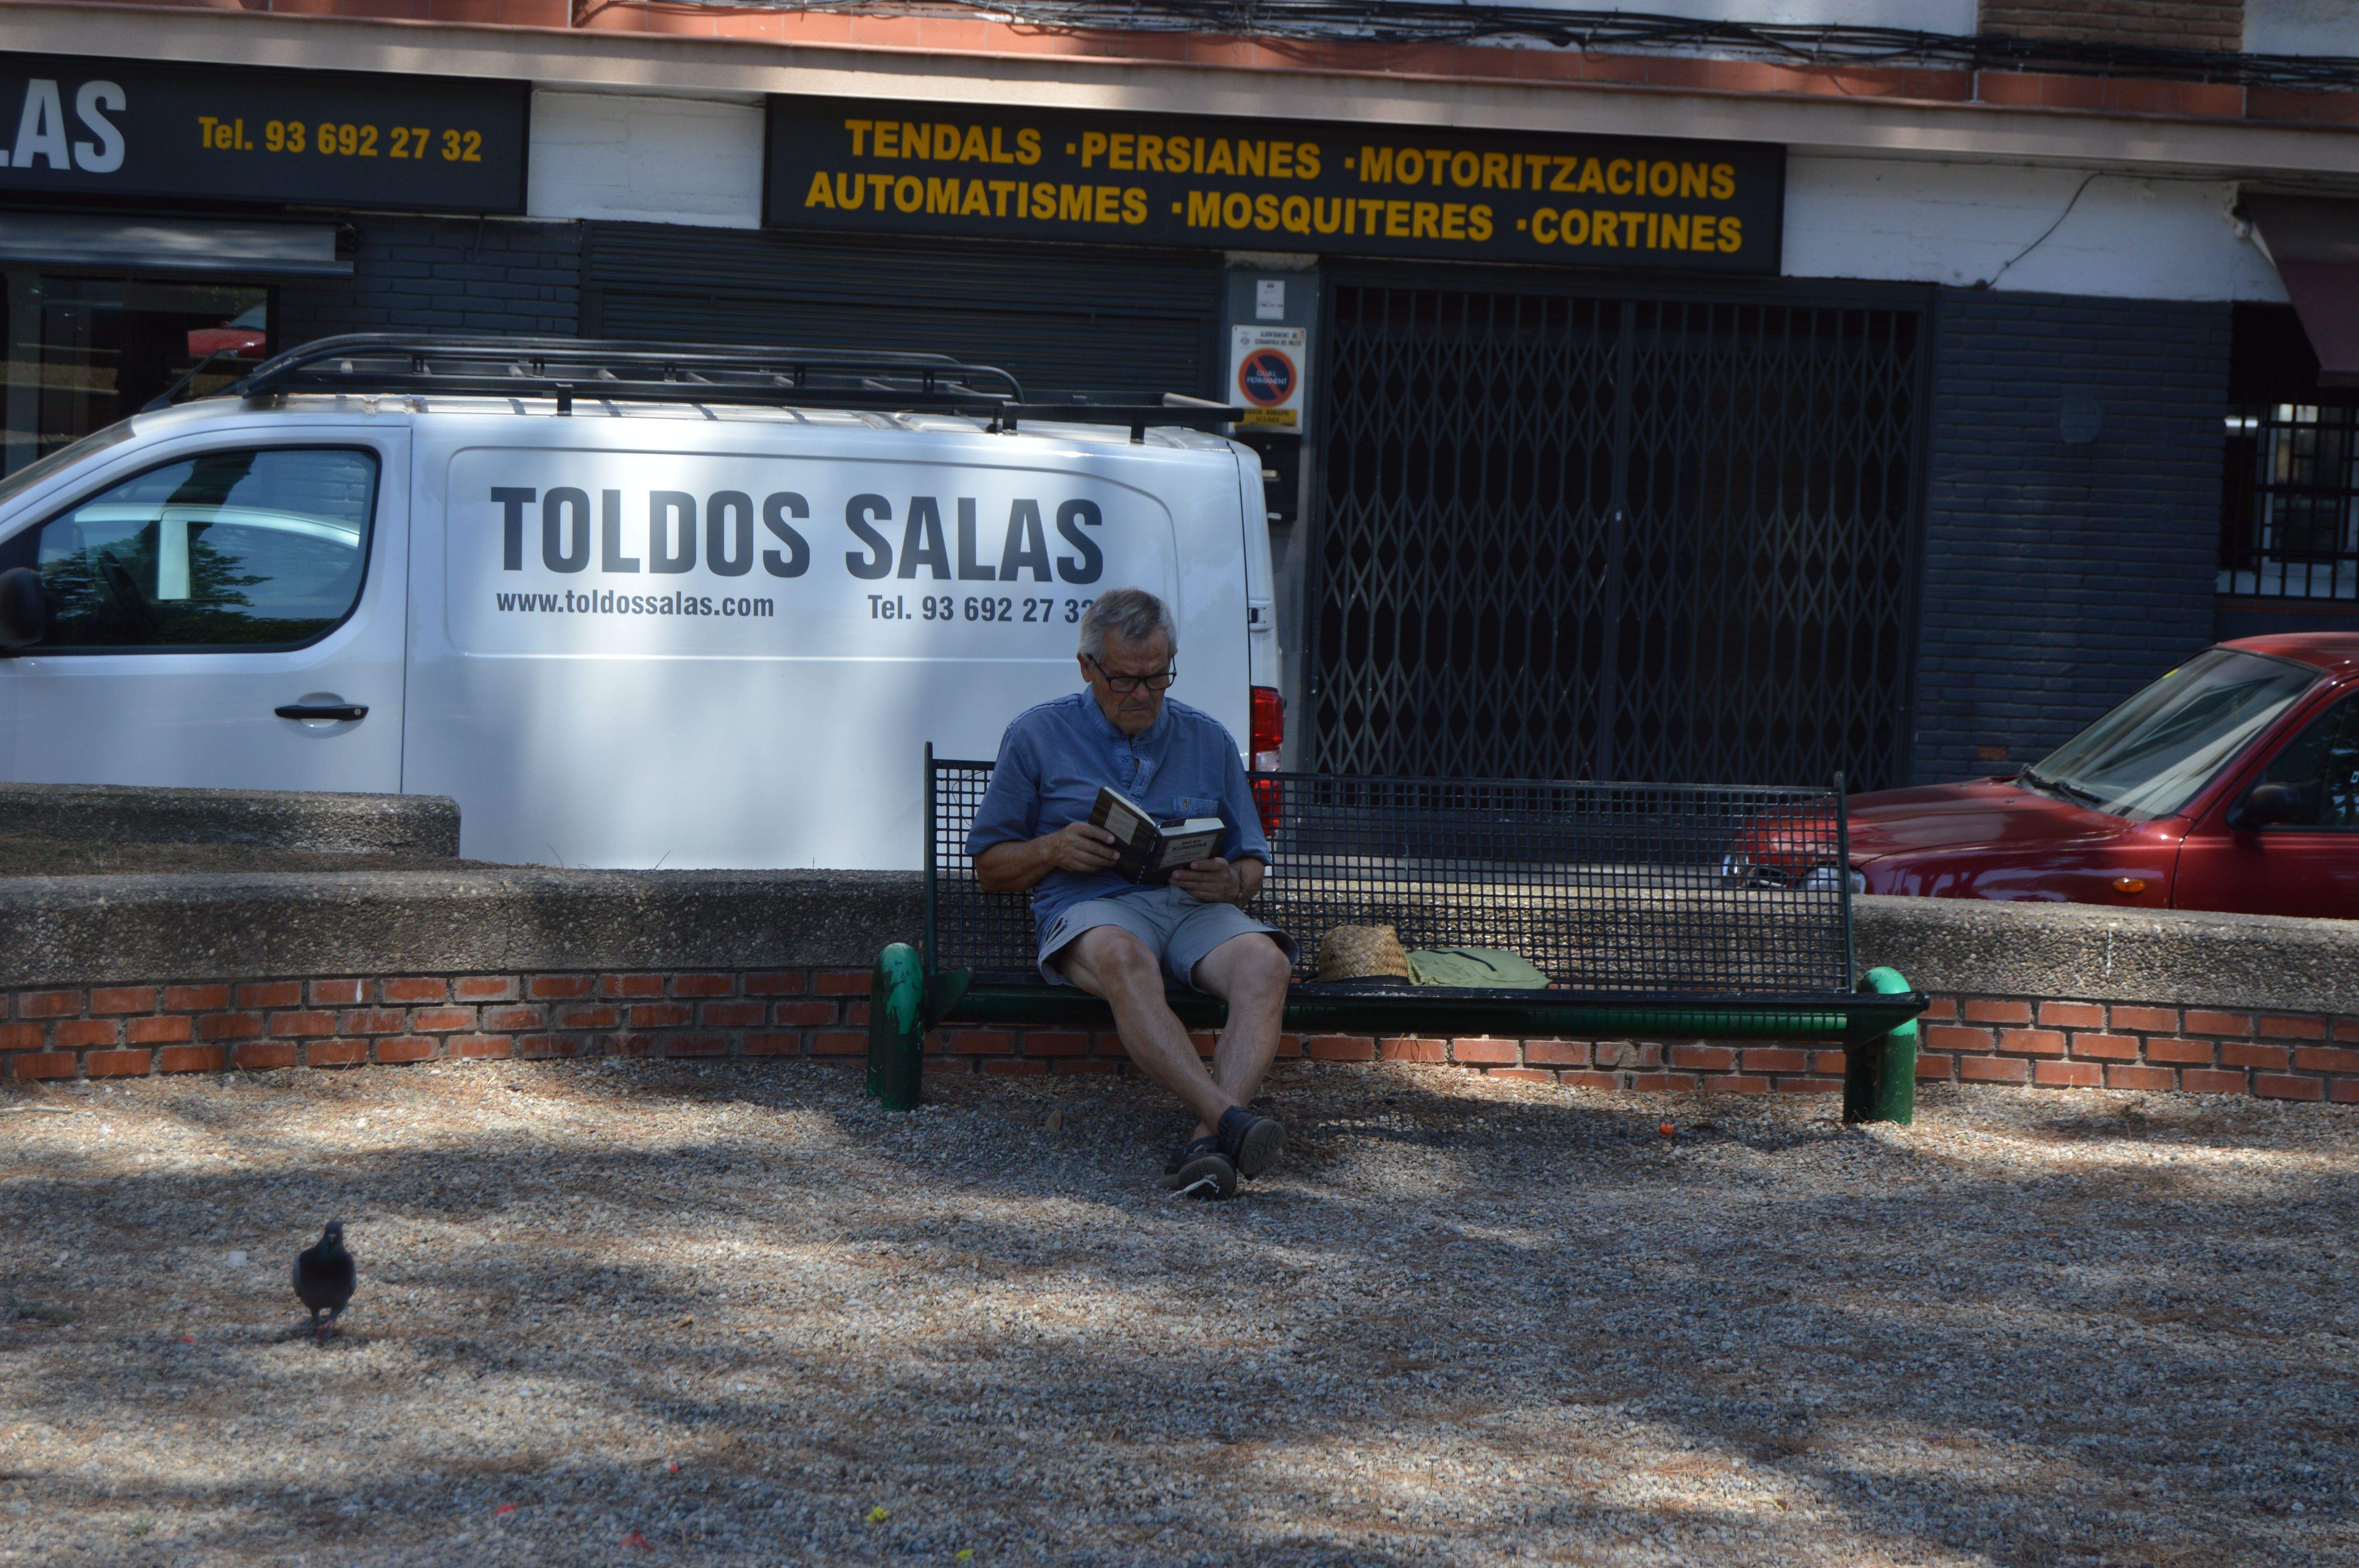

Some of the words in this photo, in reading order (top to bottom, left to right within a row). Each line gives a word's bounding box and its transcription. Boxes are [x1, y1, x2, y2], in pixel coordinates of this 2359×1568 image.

[0, 78, 125, 173] AS
[199, 116, 253, 150] Tel.
[266, 120, 305, 153] 93
[318, 123, 378, 156] 692
[389, 127, 431, 159] 27
[442, 130, 482, 162] 32
[845, 119, 1041, 165] TENDALS
[805, 171, 1148, 225] AUTOMATISMES
[491, 487, 810, 579] TOLDOS
[846, 494, 1103, 584] SALAS
[497, 590, 773, 617] www.toldossalas.com
[868, 595, 911, 619] Tel.
[923, 596, 954, 621] 93
[965, 597, 1012, 622] 692
[1023, 598, 1054, 622] 27
[1172, 843, 1207, 851] KUNDERA
